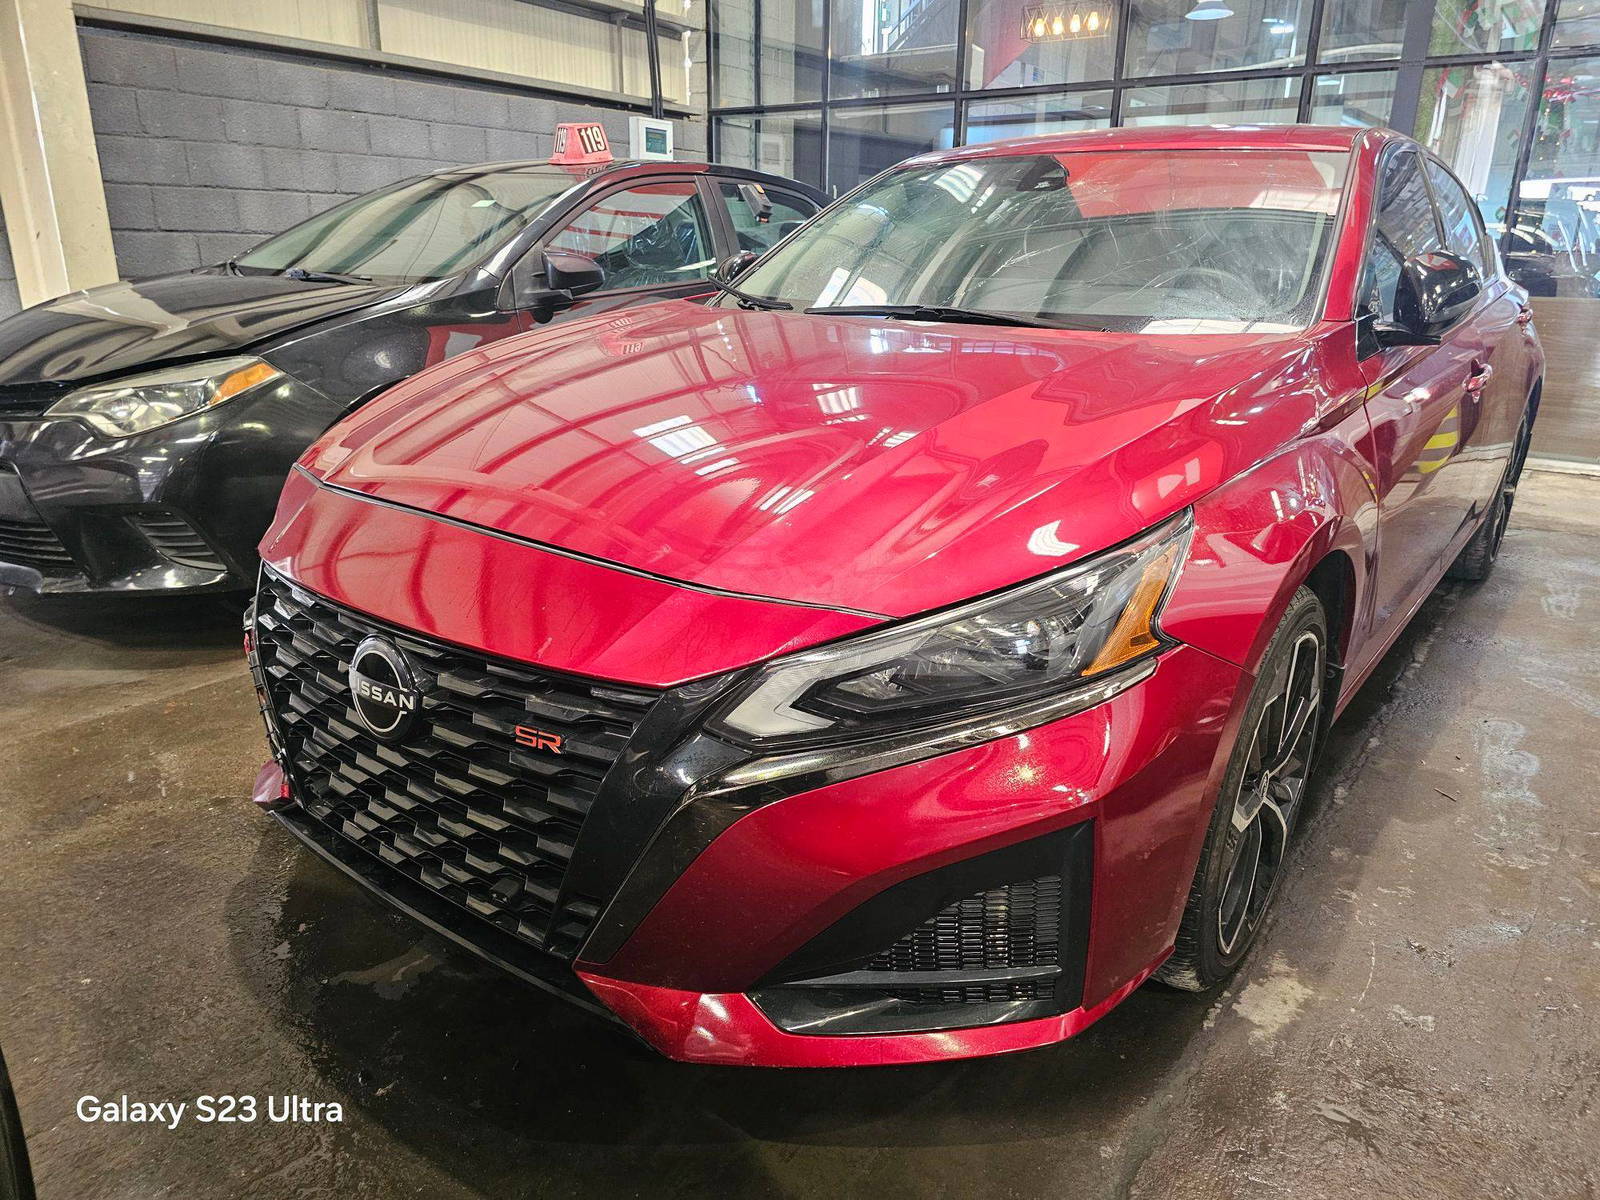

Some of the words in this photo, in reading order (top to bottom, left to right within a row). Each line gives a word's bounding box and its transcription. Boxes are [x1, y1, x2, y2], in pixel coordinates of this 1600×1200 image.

[580, 126, 606, 153] 119
[353, 677, 414, 710] ISSAN
[515, 725, 562, 754] SR
